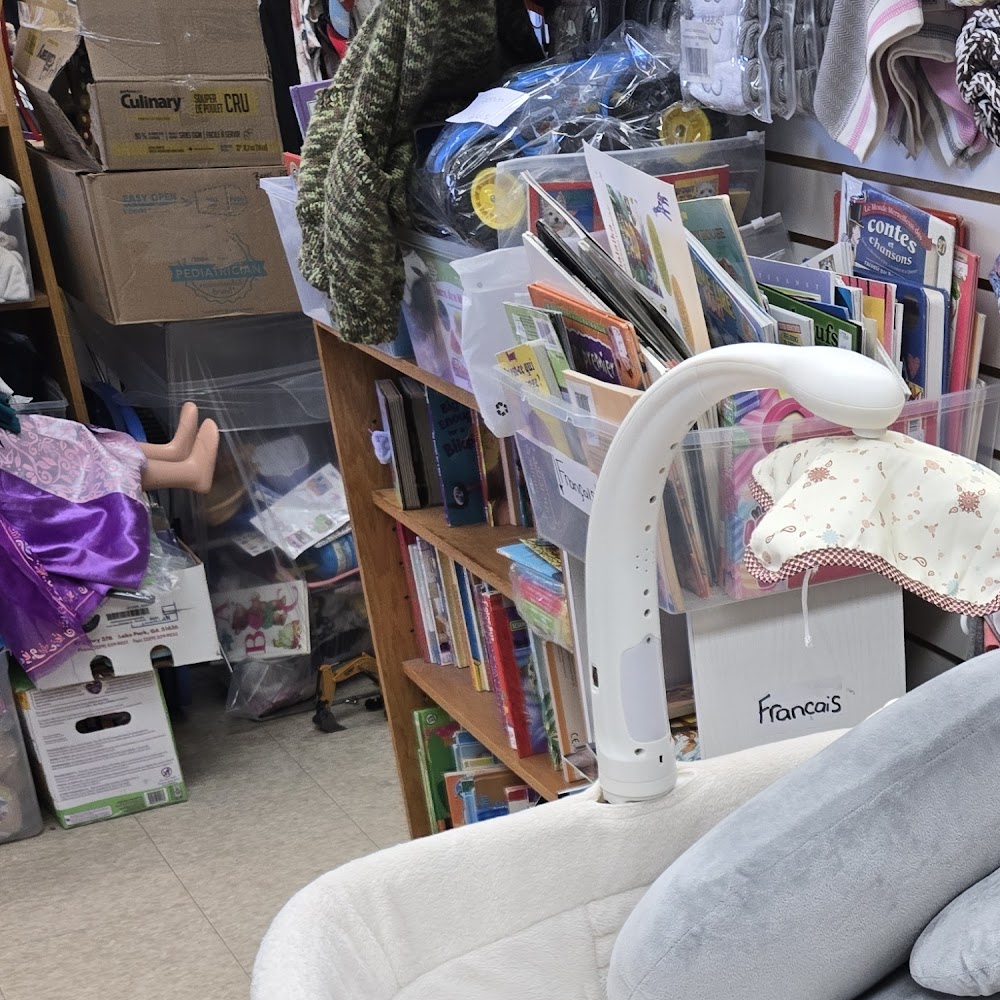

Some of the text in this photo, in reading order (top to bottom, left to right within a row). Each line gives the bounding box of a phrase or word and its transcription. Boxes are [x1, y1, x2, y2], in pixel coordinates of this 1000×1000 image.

[120, 94, 182, 112] Culinary
[224, 93, 249, 112] CRU
[868, 219, 917, 254] contes
[868, 236, 912, 266] chansons
[176, 263, 262, 278] PEDIATRICIAN
[759, 694, 842, 724] Francais
